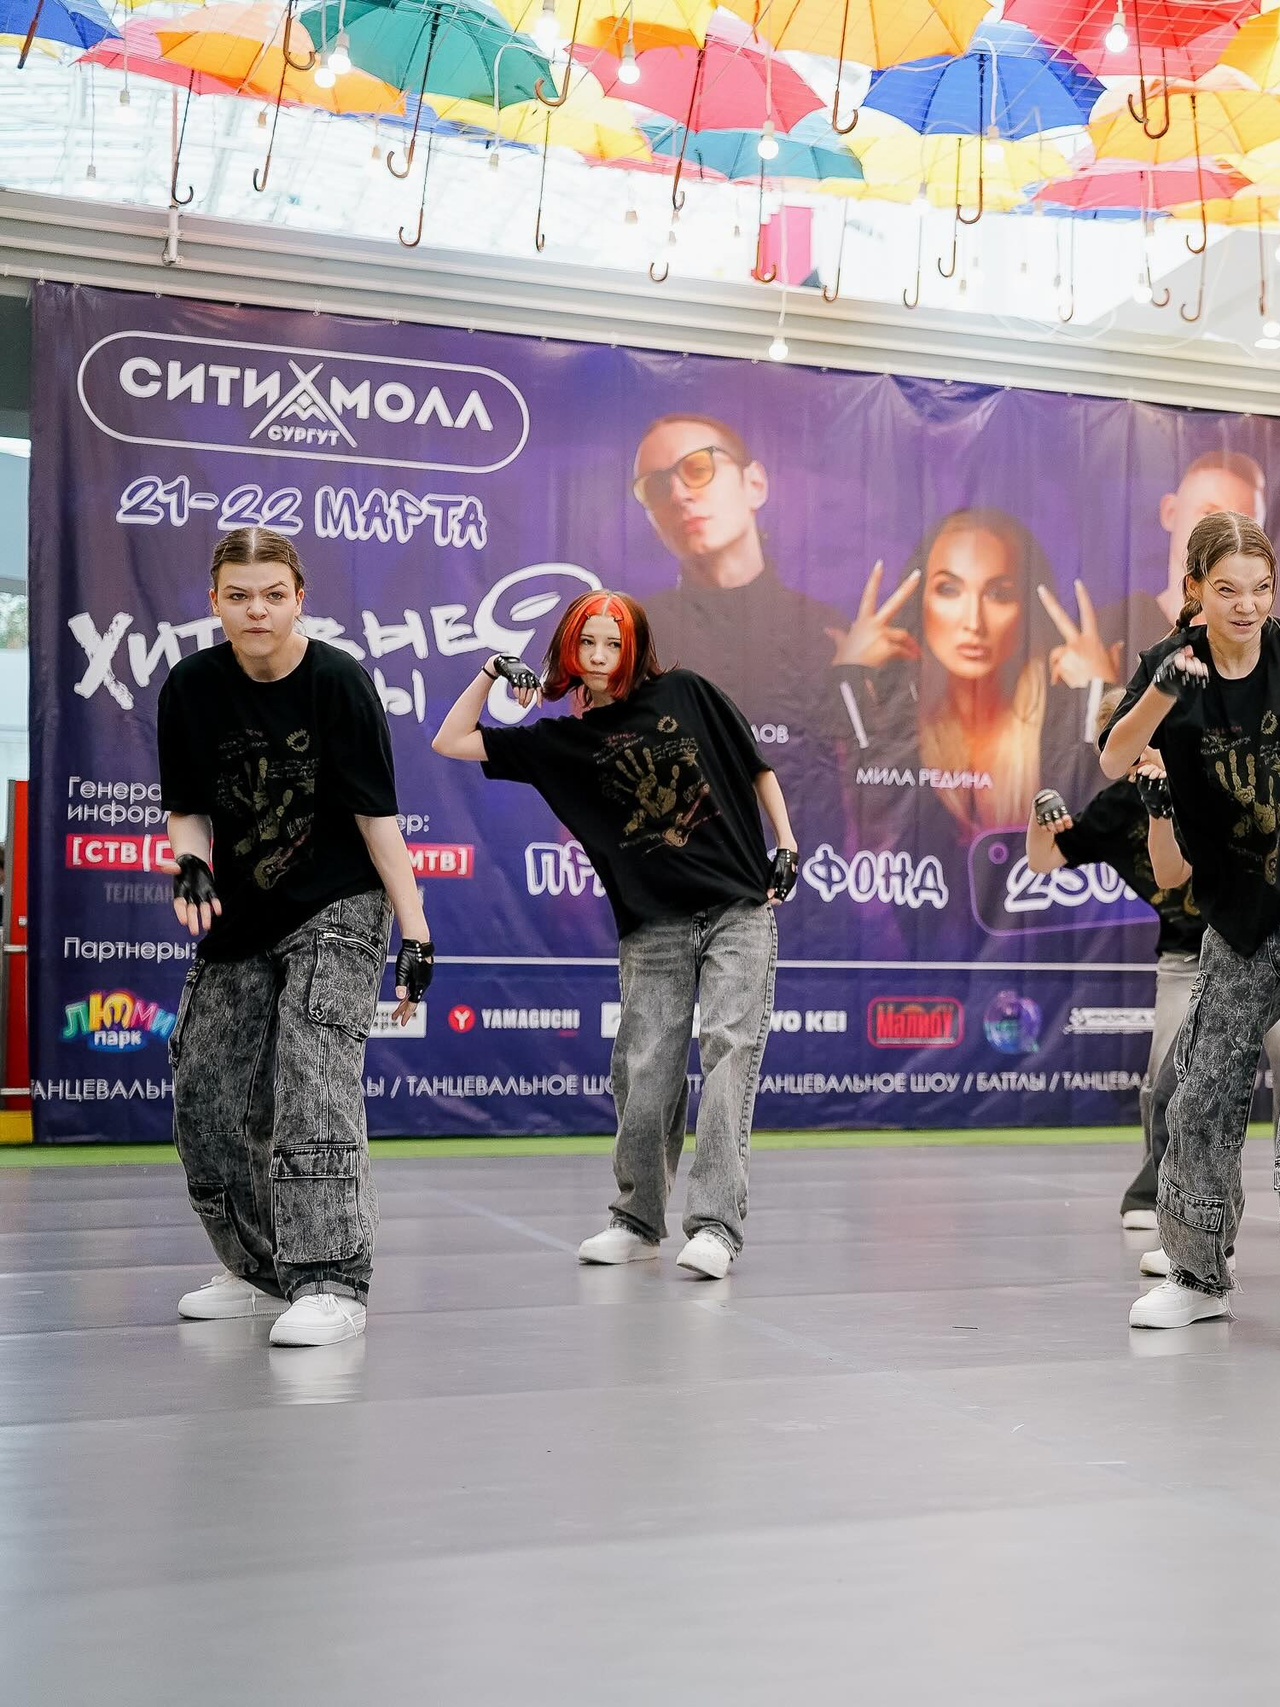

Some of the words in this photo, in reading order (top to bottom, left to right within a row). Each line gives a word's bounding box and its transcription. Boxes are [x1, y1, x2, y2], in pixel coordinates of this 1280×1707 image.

[119, 356, 281, 408] СИТИ
[329, 376, 494, 431] МОЛЛ
[267, 424, 341, 446] СУРГУТ
[115, 474, 304, 535] 21-22
[315, 485, 489, 550] МАРТА
[67, 604, 476, 710] ХИТВЫЕ
[856, 766, 916, 787] МИЛА
[919, 768, 994, 789] РЕДИНА
[104, 882, 174, 903] ТЕЛЕКАН
[64, 936, 197, 963] Партнеры:
[481, 1008, 580, 1029] YAMAGUCHI
[94, 1030, 142, 1049] парк
[31, 1078, 175, 1102] АНЦЕВАЛЬН
[406, 1074, 578, 1097] ТАНЦЕВАЛЬНОЕ
[757, 1072, 906, 1095] АНЦЕВАЛЬНОЕ
[910, 1072, 960, 1092] ШОУ
[976, 1071, 1046, 1092] БАТТЛЫ
[1062, 1070, 1149, 1092] ТАНЦЕВА
